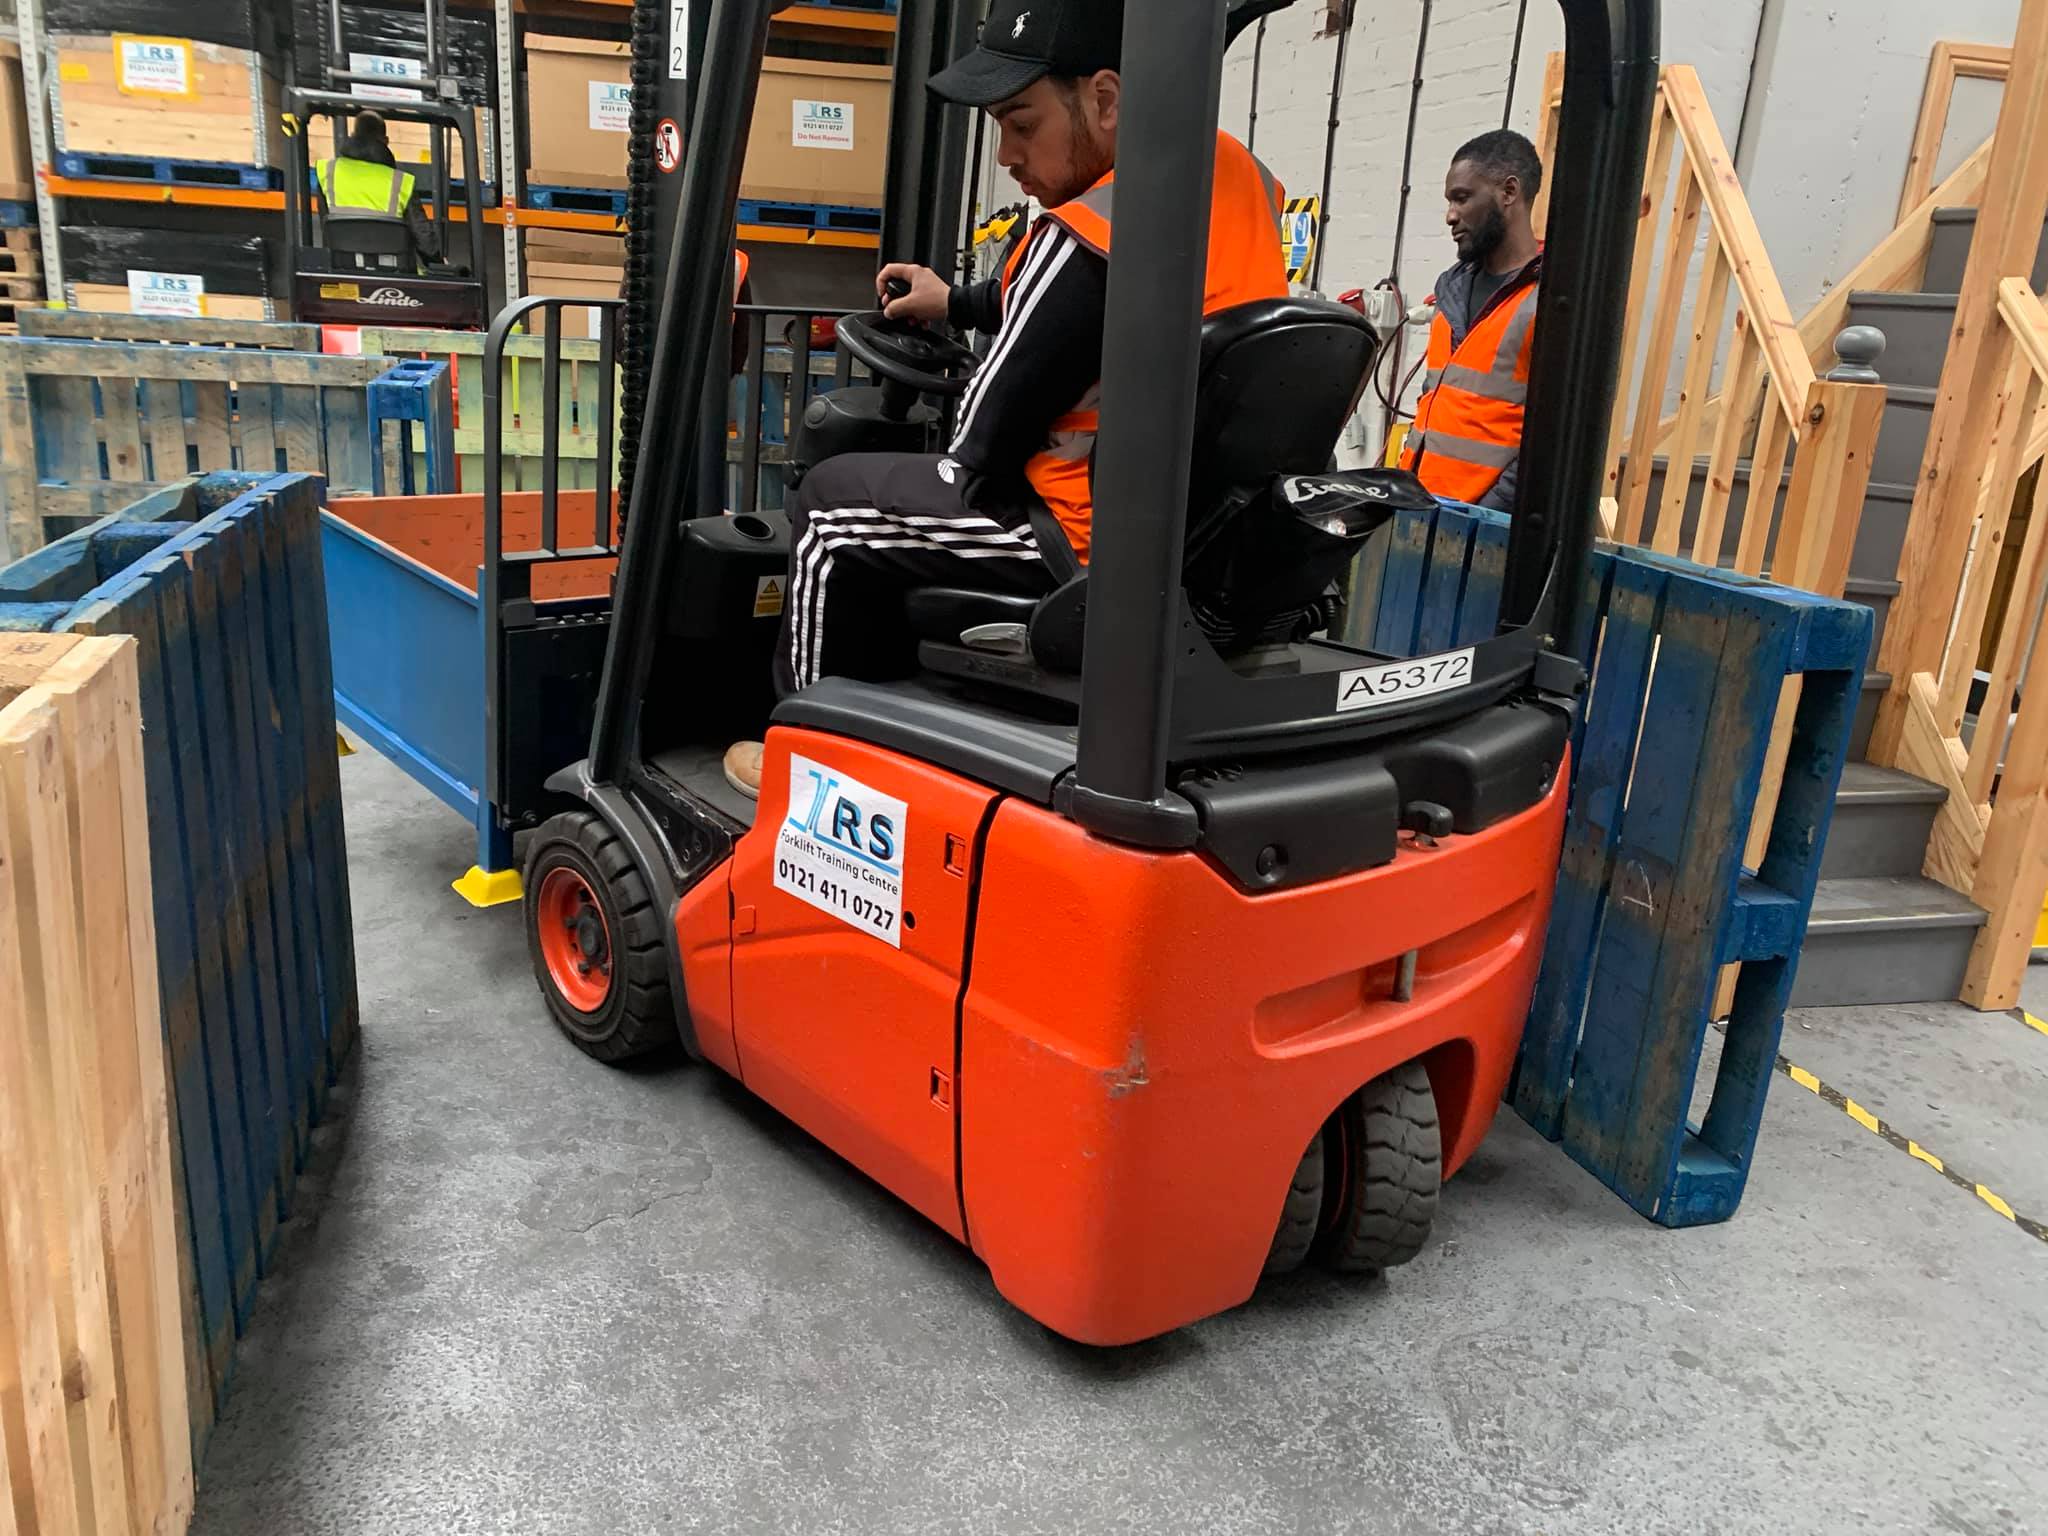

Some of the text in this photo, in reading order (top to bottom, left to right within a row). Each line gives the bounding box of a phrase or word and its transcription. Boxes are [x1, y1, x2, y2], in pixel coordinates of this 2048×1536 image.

[132, 44, 174, 60] IRS
[366, 57, 406, 74] IRS
[805, 103, 842, 118] IRS
[146, 272, 187, 289] IRS
[356, 287, 424, 307] Linde
[1342, 656, 1468, 701] A5372
[789, 770, 895, 864] IRS
[781, 828, 898, 896] Forklift Training Centre
[779, 859, 894, 931] 0121 411 0727
